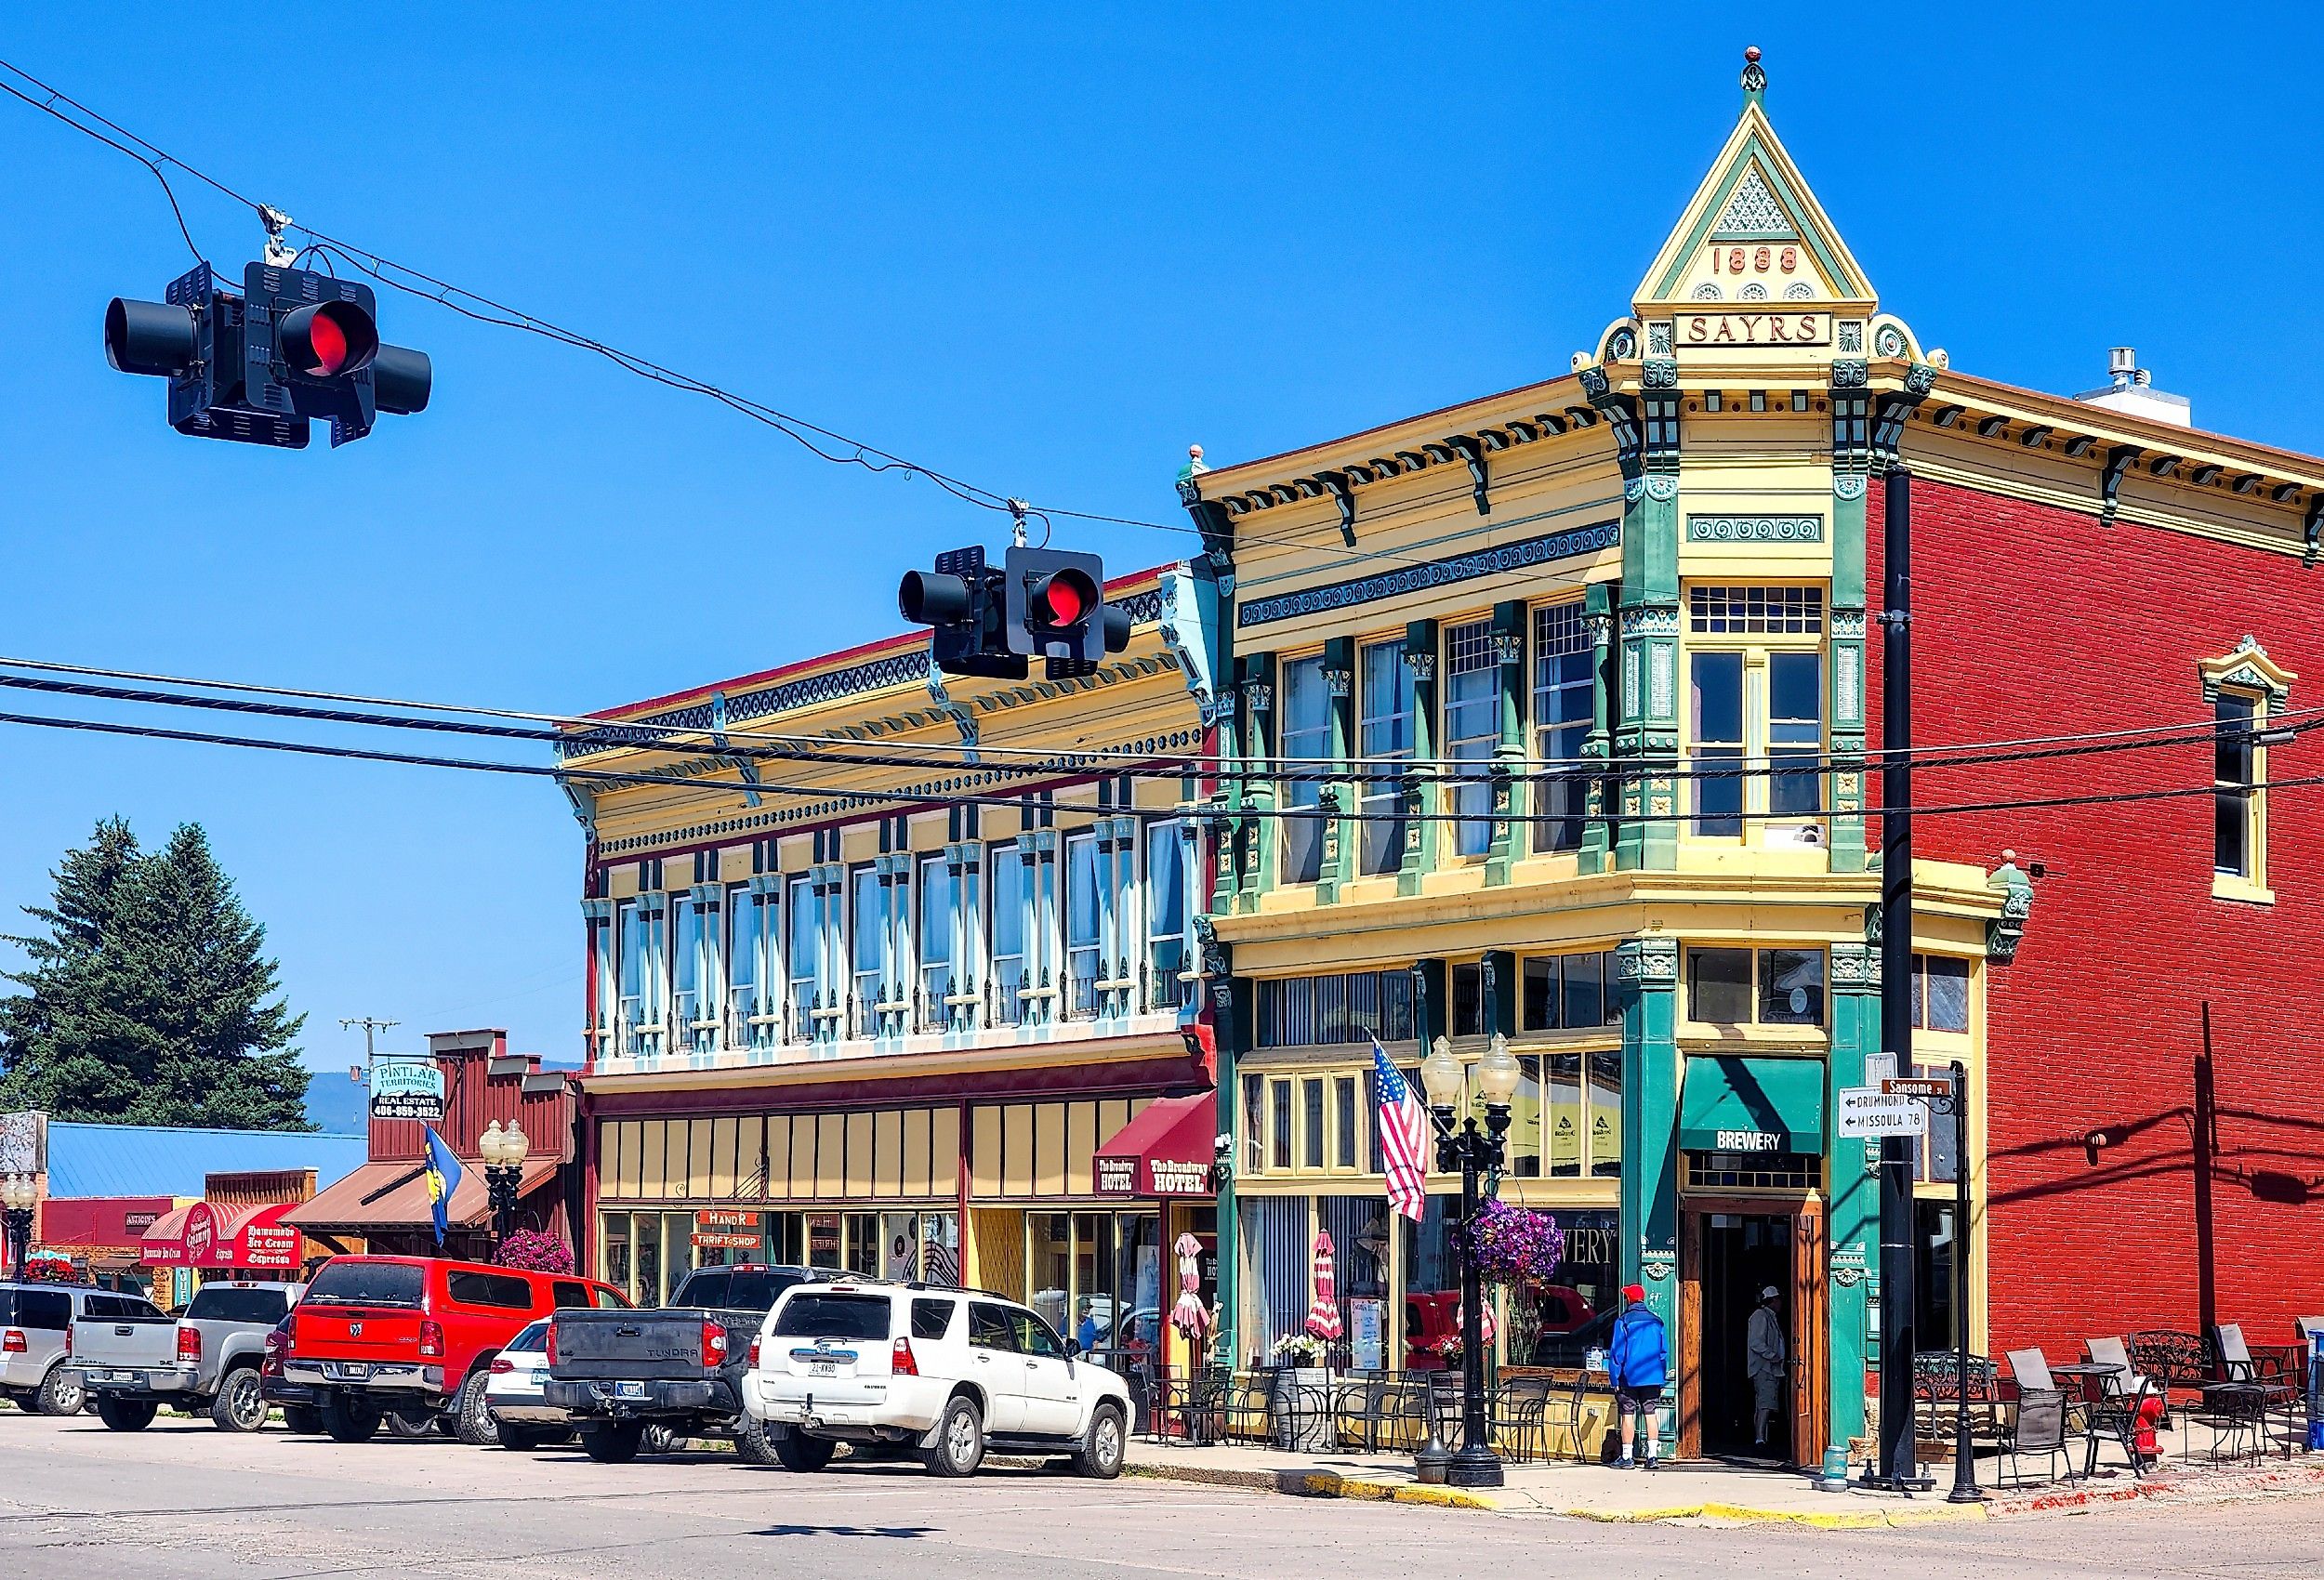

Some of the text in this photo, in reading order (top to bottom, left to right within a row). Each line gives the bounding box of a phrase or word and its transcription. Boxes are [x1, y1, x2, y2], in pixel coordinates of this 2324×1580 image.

[1713, 247, 1797, 270] 1888
[1688, 315, 1816, 342] SAYRS
[380, 1066, 436, 1081] PINTLAR
[380, 1078, 436, 1089] TERRITORIES
[1889, 1080, 1932, 1094] Sansome
[378, 1097, 437, 1106] REAL ESTATE
[1857, 1096, 1905, 1108] DRUMMOND
[1857, 1113, 1920, 1127] MISSOULA 78
[1717, 1130, 1781, 1151] BREWERY
[1099, 1159, 1134, 1174] The Broadway
[1150, 1159, 1208, 1176] The Broadway
[1101, 1173, 1131, 1191] HOTEL
[1154, 1173, 1204, 1192] HOTEL
[265, 1238, 294, 1248] Cream
[697, 1235, 756, 1246] THRIFT SHOP
[647, 1349, 698, 1358] TUNDRA
